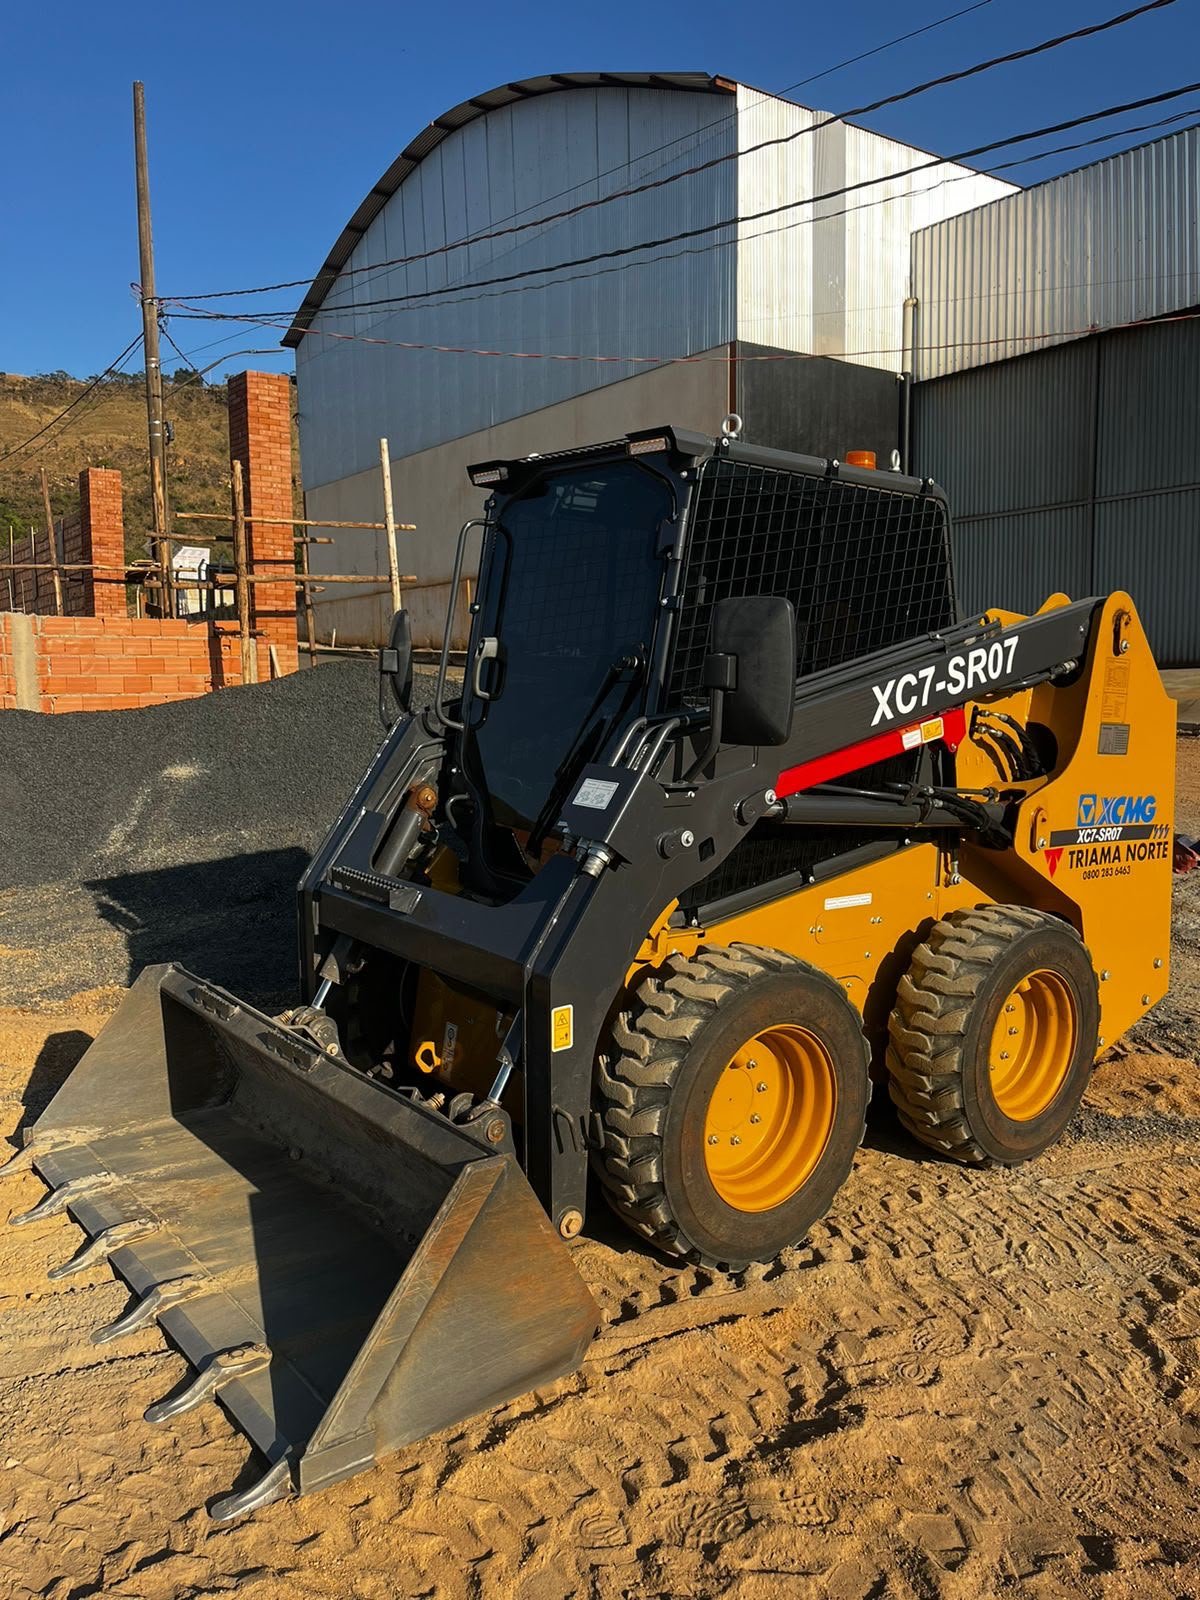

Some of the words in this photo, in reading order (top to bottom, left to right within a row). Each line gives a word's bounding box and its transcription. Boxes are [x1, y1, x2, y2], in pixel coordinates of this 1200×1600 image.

[870, 635, 1019, 727] XC7-SR07
[1096, 795, 1156, 825] XCMG
[1077, 827, 1123, 843] XC7-SR07
[1068, 845, 1121, 869] TRIAMA
[1126, 841, 1168, 861] NORTE
[1083, 869, 1099, 880] 0800
[1101, 867, 1114, 878] 283
[1114, 865, 1131, 877] 6463
